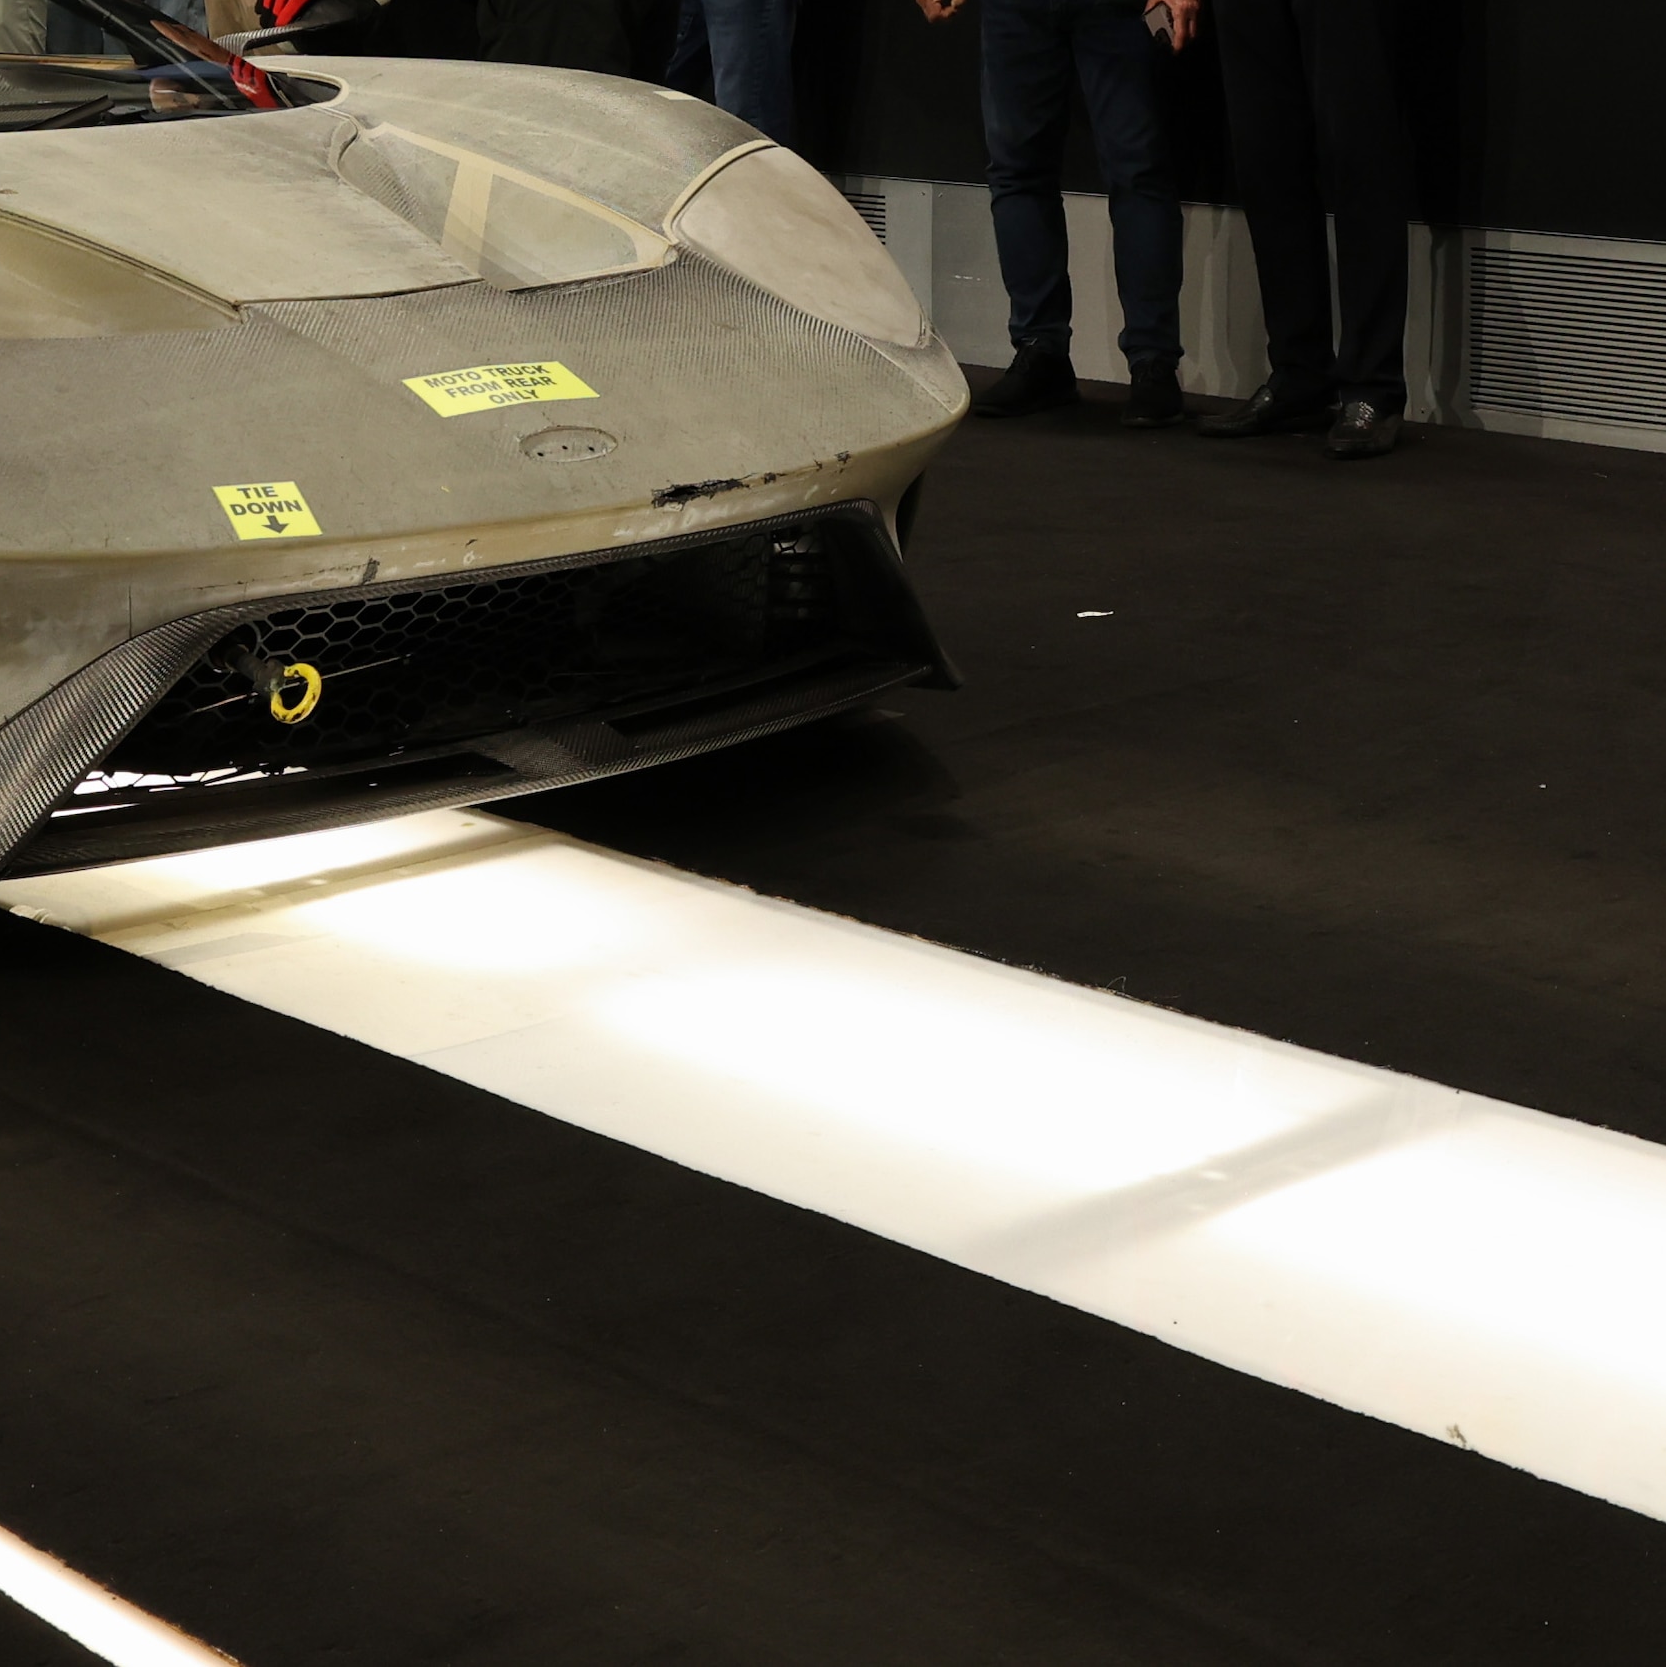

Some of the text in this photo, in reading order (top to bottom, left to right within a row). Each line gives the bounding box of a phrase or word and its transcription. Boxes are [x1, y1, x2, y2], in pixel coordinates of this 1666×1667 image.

[424, 364, 550, 389] MOTO TRUCK
[444, 376, 557, 398] FROM REAR
[489, 389, 541, 405] ONLY
[236, 485, 279, 499] TIE
[229, 499, 304, 516] DOWN
